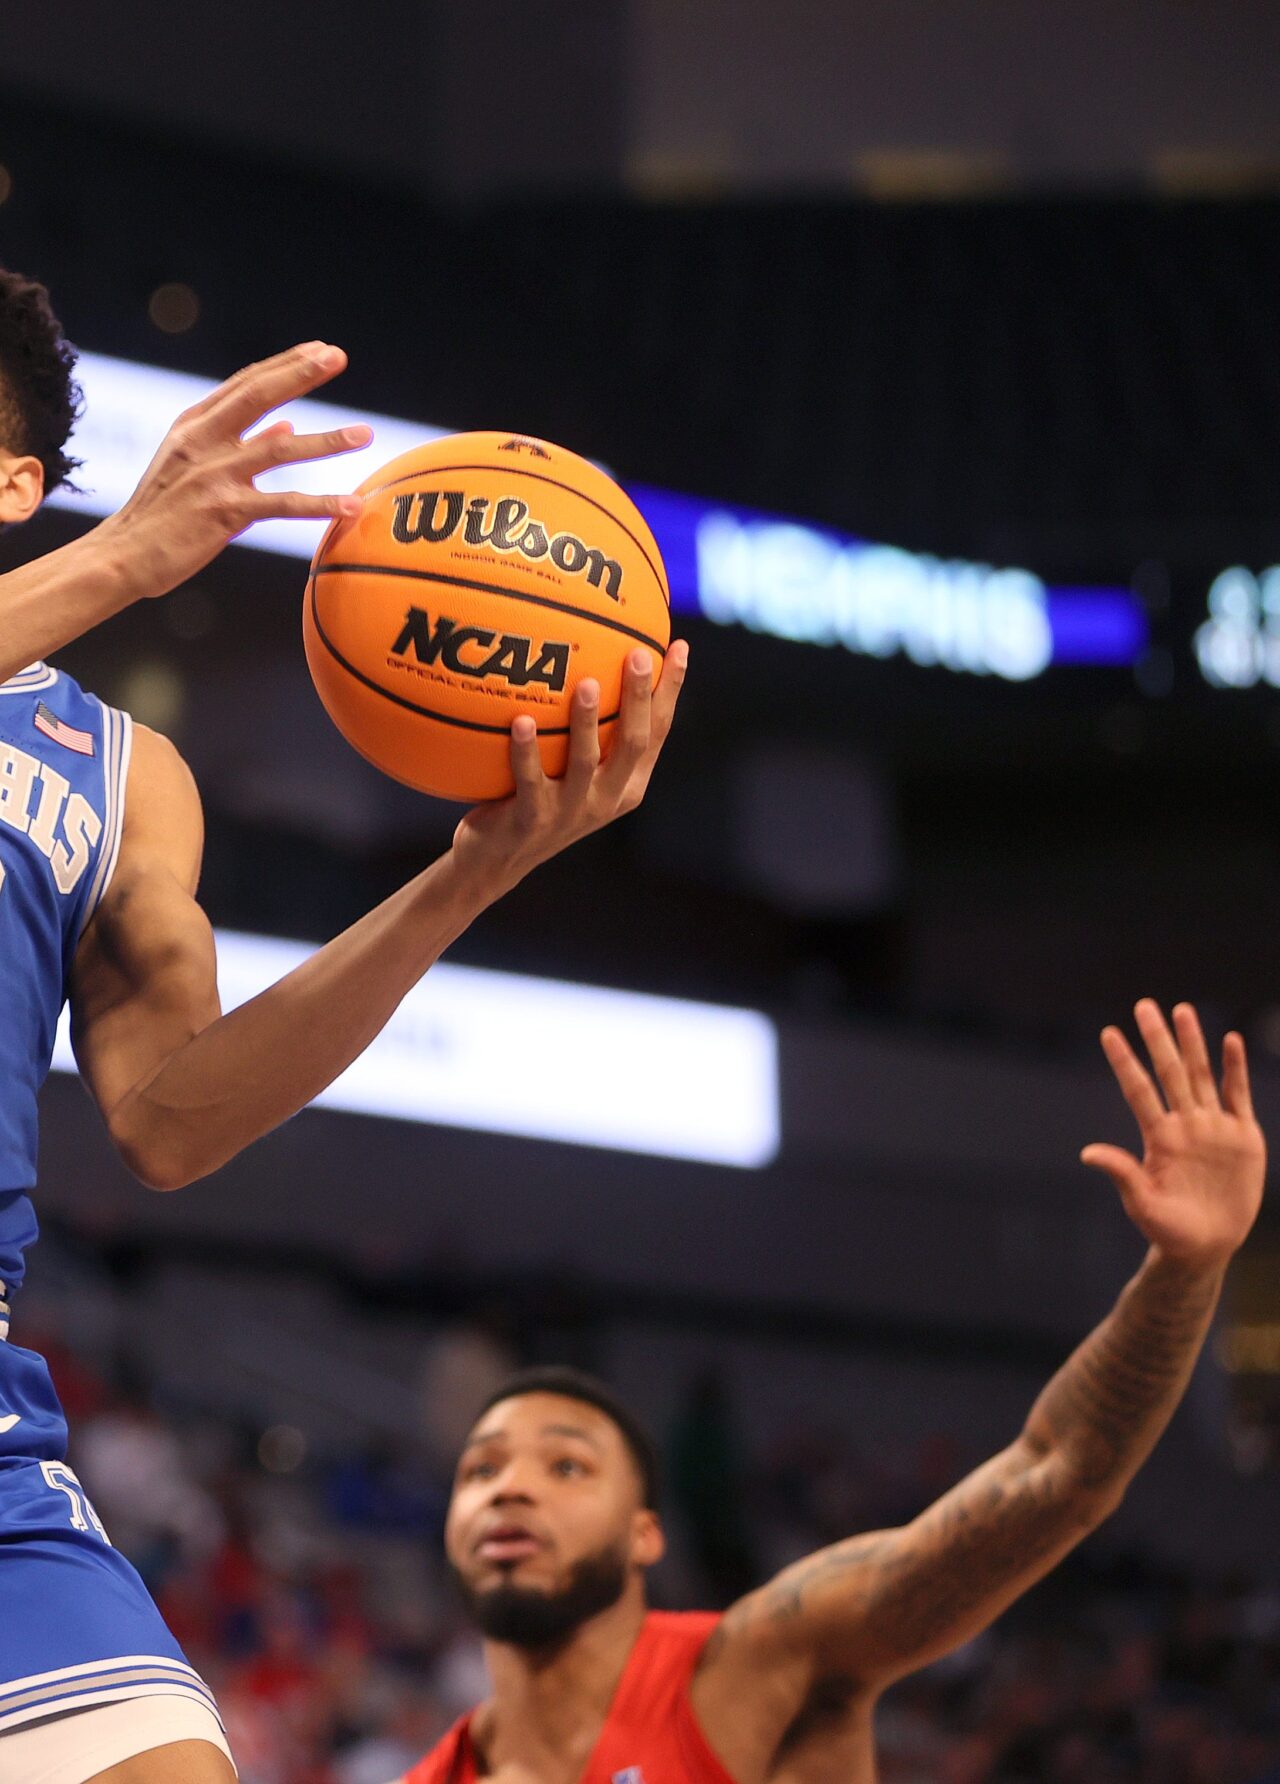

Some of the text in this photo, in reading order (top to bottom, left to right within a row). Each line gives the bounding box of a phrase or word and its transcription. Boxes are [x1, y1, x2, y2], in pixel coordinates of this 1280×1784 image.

[391, 490, 624, 602] Wilson
[536, 571, 563, 585] BALL
[386, 657, 560, 705] OFFICIAL GAME BALL
[390, 605, 571, 693] NCAA
